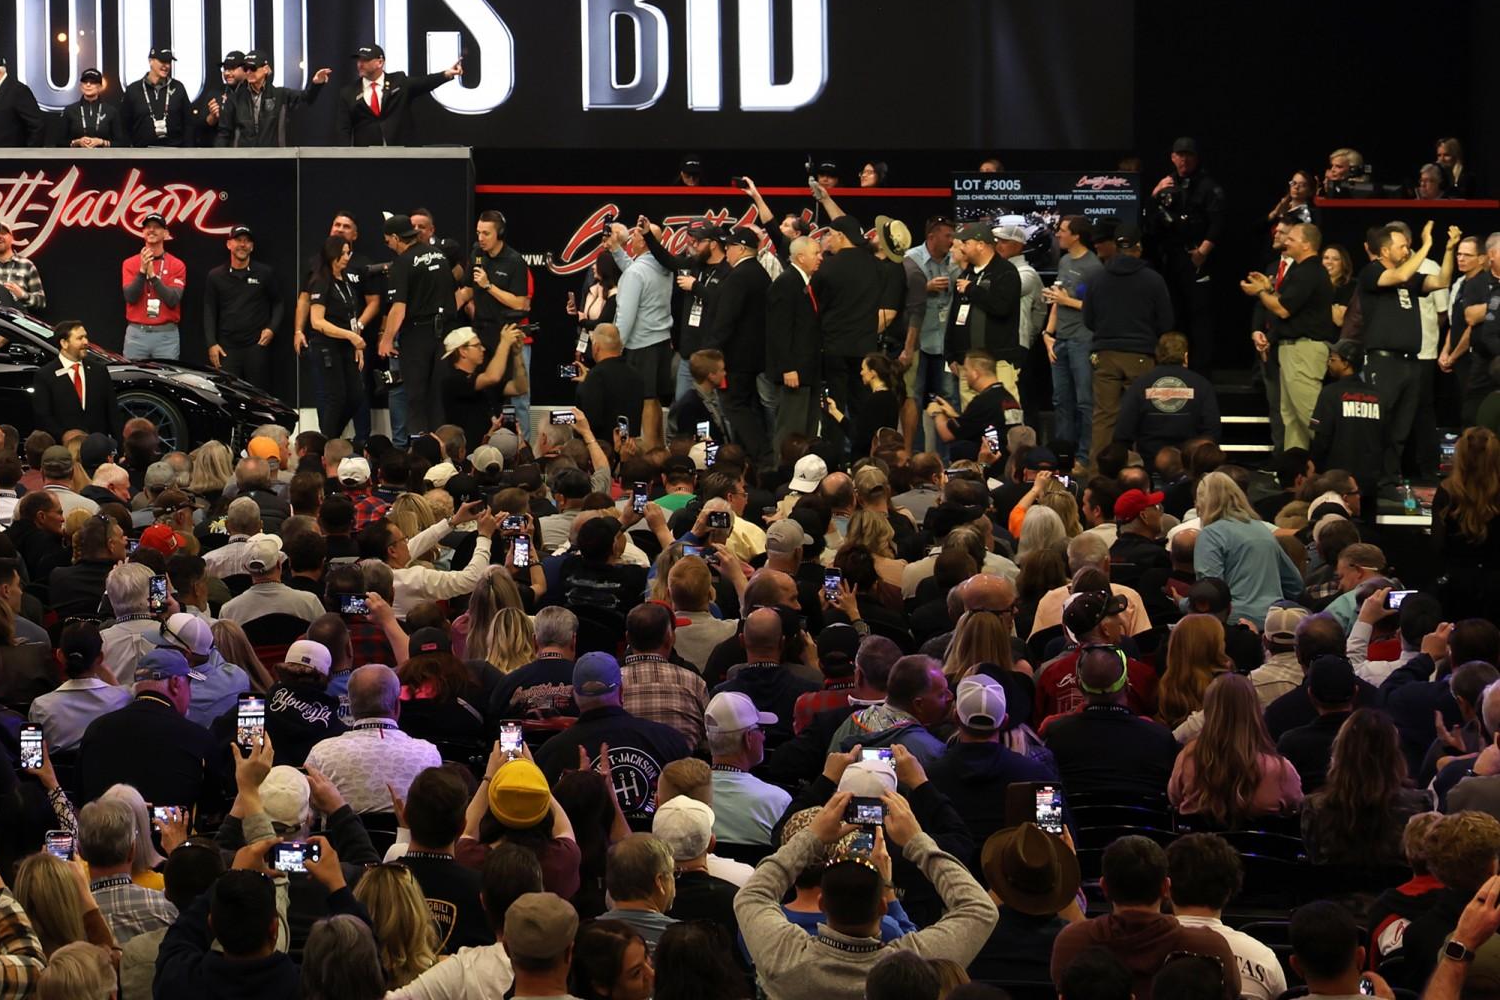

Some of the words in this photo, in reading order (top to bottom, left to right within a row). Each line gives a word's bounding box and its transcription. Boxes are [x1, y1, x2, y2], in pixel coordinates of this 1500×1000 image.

[954, 179, 980, 191] LOT
[984, 179, 1022, 191] #3005
[1083, 207, 1117, 215] CHARITY
[1342, 401, 1381, 420] MEDIA
